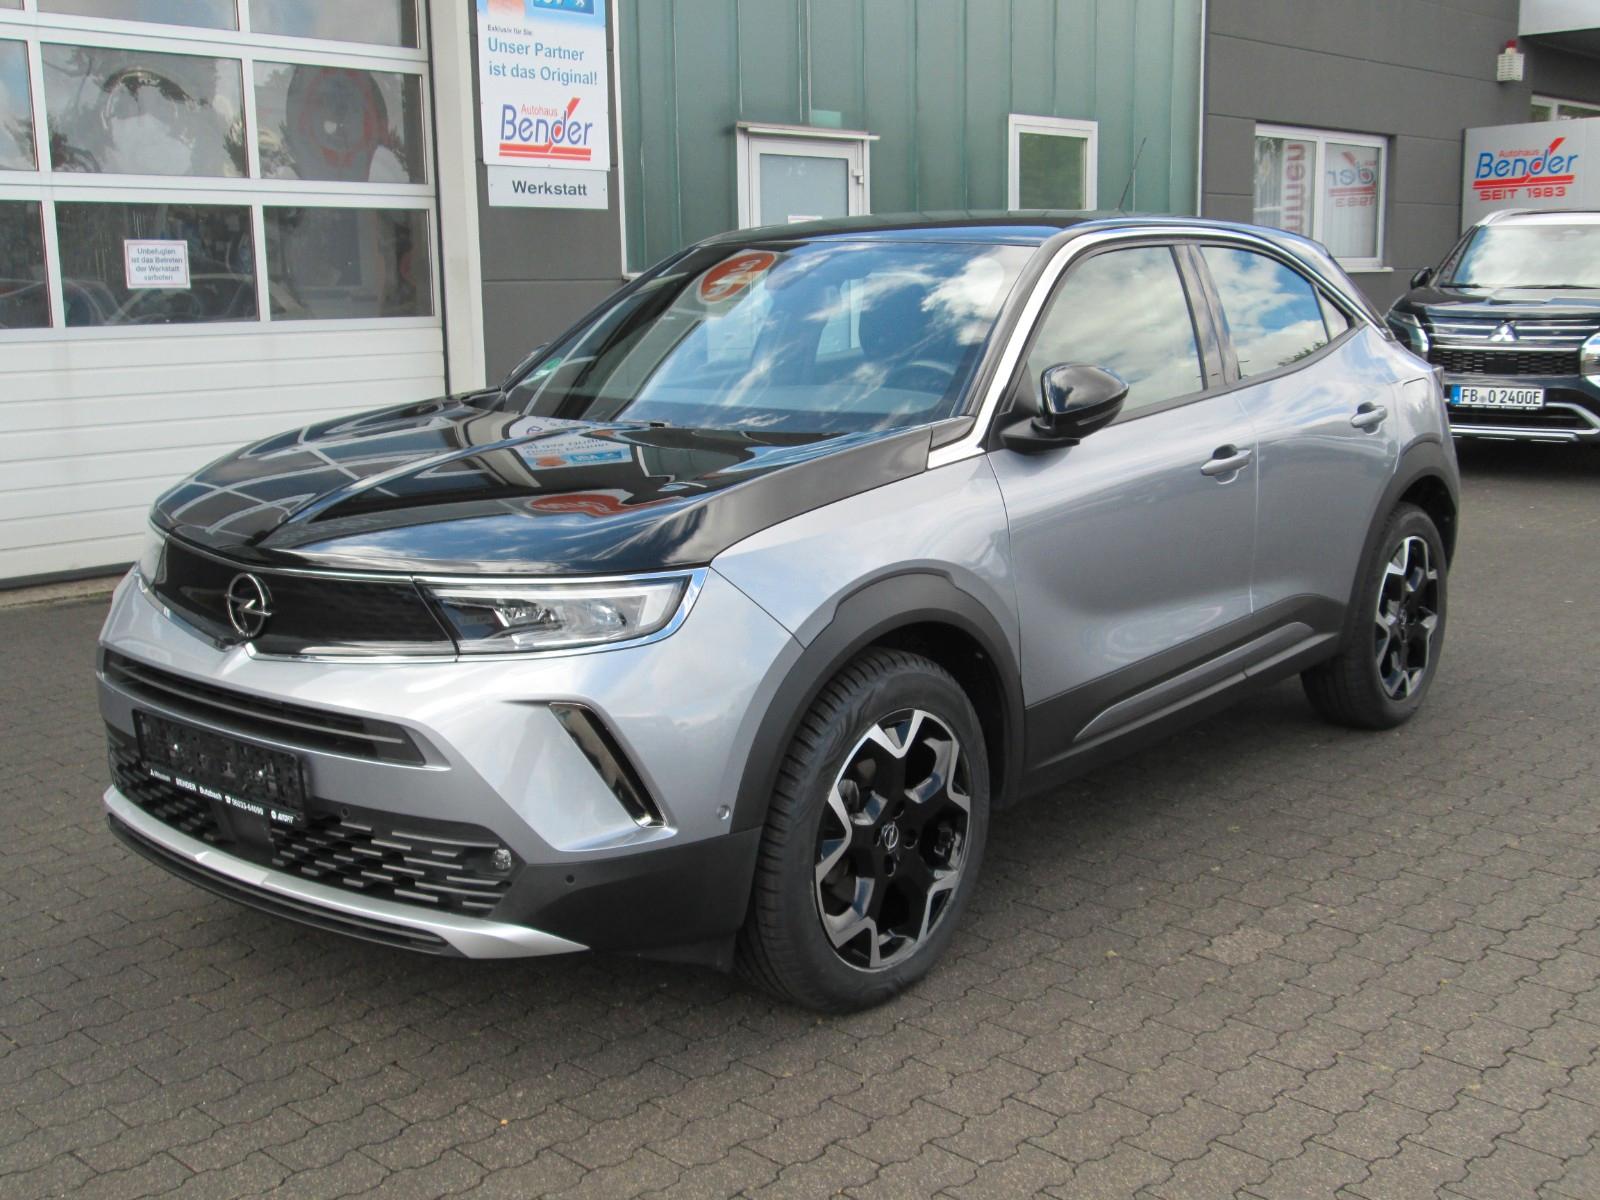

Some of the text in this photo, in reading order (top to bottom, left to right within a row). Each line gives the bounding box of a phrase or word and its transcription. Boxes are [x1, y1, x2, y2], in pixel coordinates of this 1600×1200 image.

[488, 37, 584, 61] Unser Partner
[488, 61, 598, 86] ist das Original!
[521, 104, 558, 117] Autohaus
[500, 104, 593, 145] Bender
[1498, 149, 1540, 157] Autohaus
[1475, 148, 1578, 179] Bender
[512, 180, 588, 196] Werkstatt
[1479, 187, 1566, 201] SEIT 1983
[1461, 389, 1478, 402] FB
[1500, 390, 1541, 404] 2400E
